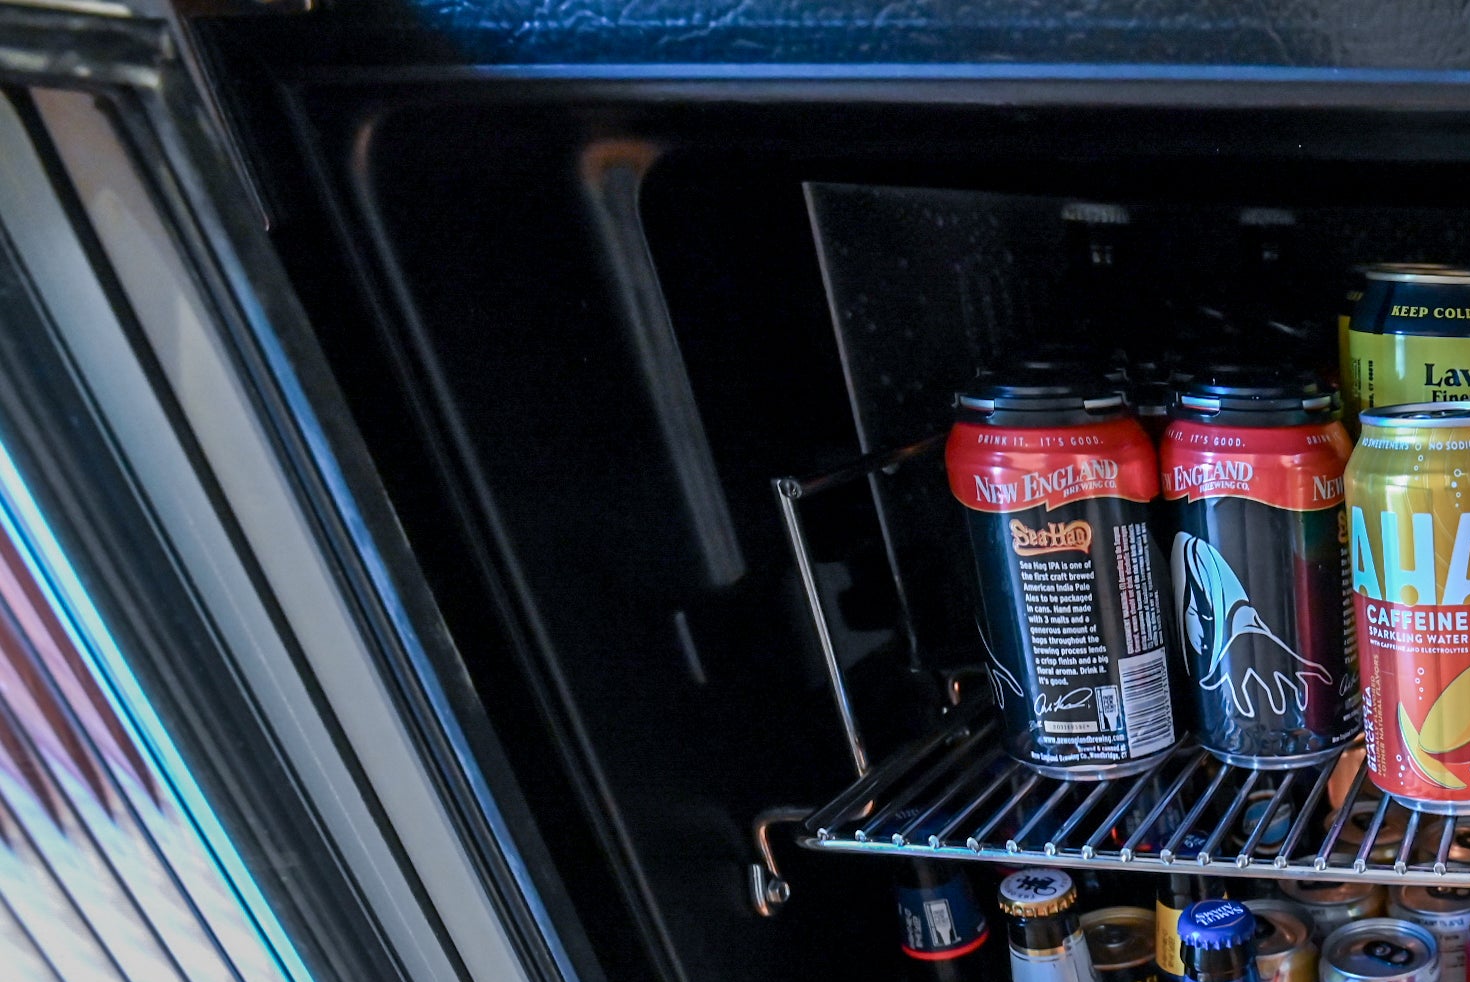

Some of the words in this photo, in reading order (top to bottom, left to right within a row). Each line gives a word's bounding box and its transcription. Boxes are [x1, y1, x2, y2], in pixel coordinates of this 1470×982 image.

[1391, 306, 1428, 318] KEEP
[978, 434, 1007, 446] DRINK
[1014, 438, 1028, 447] IT.
[1040, 438, 1064, 446] IT'S
[1071, 436, 1103, 446] GOOD.
[1191, 434, 1208, 444] IT'S
[1214, 437, 1245, 447] GOOD.
[1428, 441, 1443, 450] NO
[1022, 459, 1119, 502] ENGLAND
[1174, 461, 1253, 491] ENGLAND
[1063, 481, 1102, 498] BREWING
[1237, 483, 1249, 491] CO.
[1020, 561, 1032, 569] Sea
[1033, 561, 1047, 570] Hag
[1022, 572, 1033, 580] the
[1034, 572, 1048, 580] first
[1050, 572, 1067, 580] craft
[1069, 571, 1094, 580] brewed
[1024, 583, 1055, 592] American
[1056, 583, 1073, 591] India
[1075, 583, 1090, 591] Pale
[1026, 594, 1039, 602] Ales
[1060, 593, 1092, 603] packaged
[1367, 604, 1468, 631] CAFFEINE
[1032, 636, 1047, 644] hops
[1049, 636, 1086, 646] throughout
[1369, 626, 1422, 644] SPARKLING
[1427, 634, 1468, 644] WATER
[1034, 647, 1059, 655] brewing
[1088, 646, 1106, 654] lends
[1058, 657, 1077, 665] finish
[1373, 654, 1381, 696] FLAVORS
[1050, 678, 1068, 686] good.
[1364, 687, 1372, 714] TEA
[1366, 721, 1377, 772] BLACK
